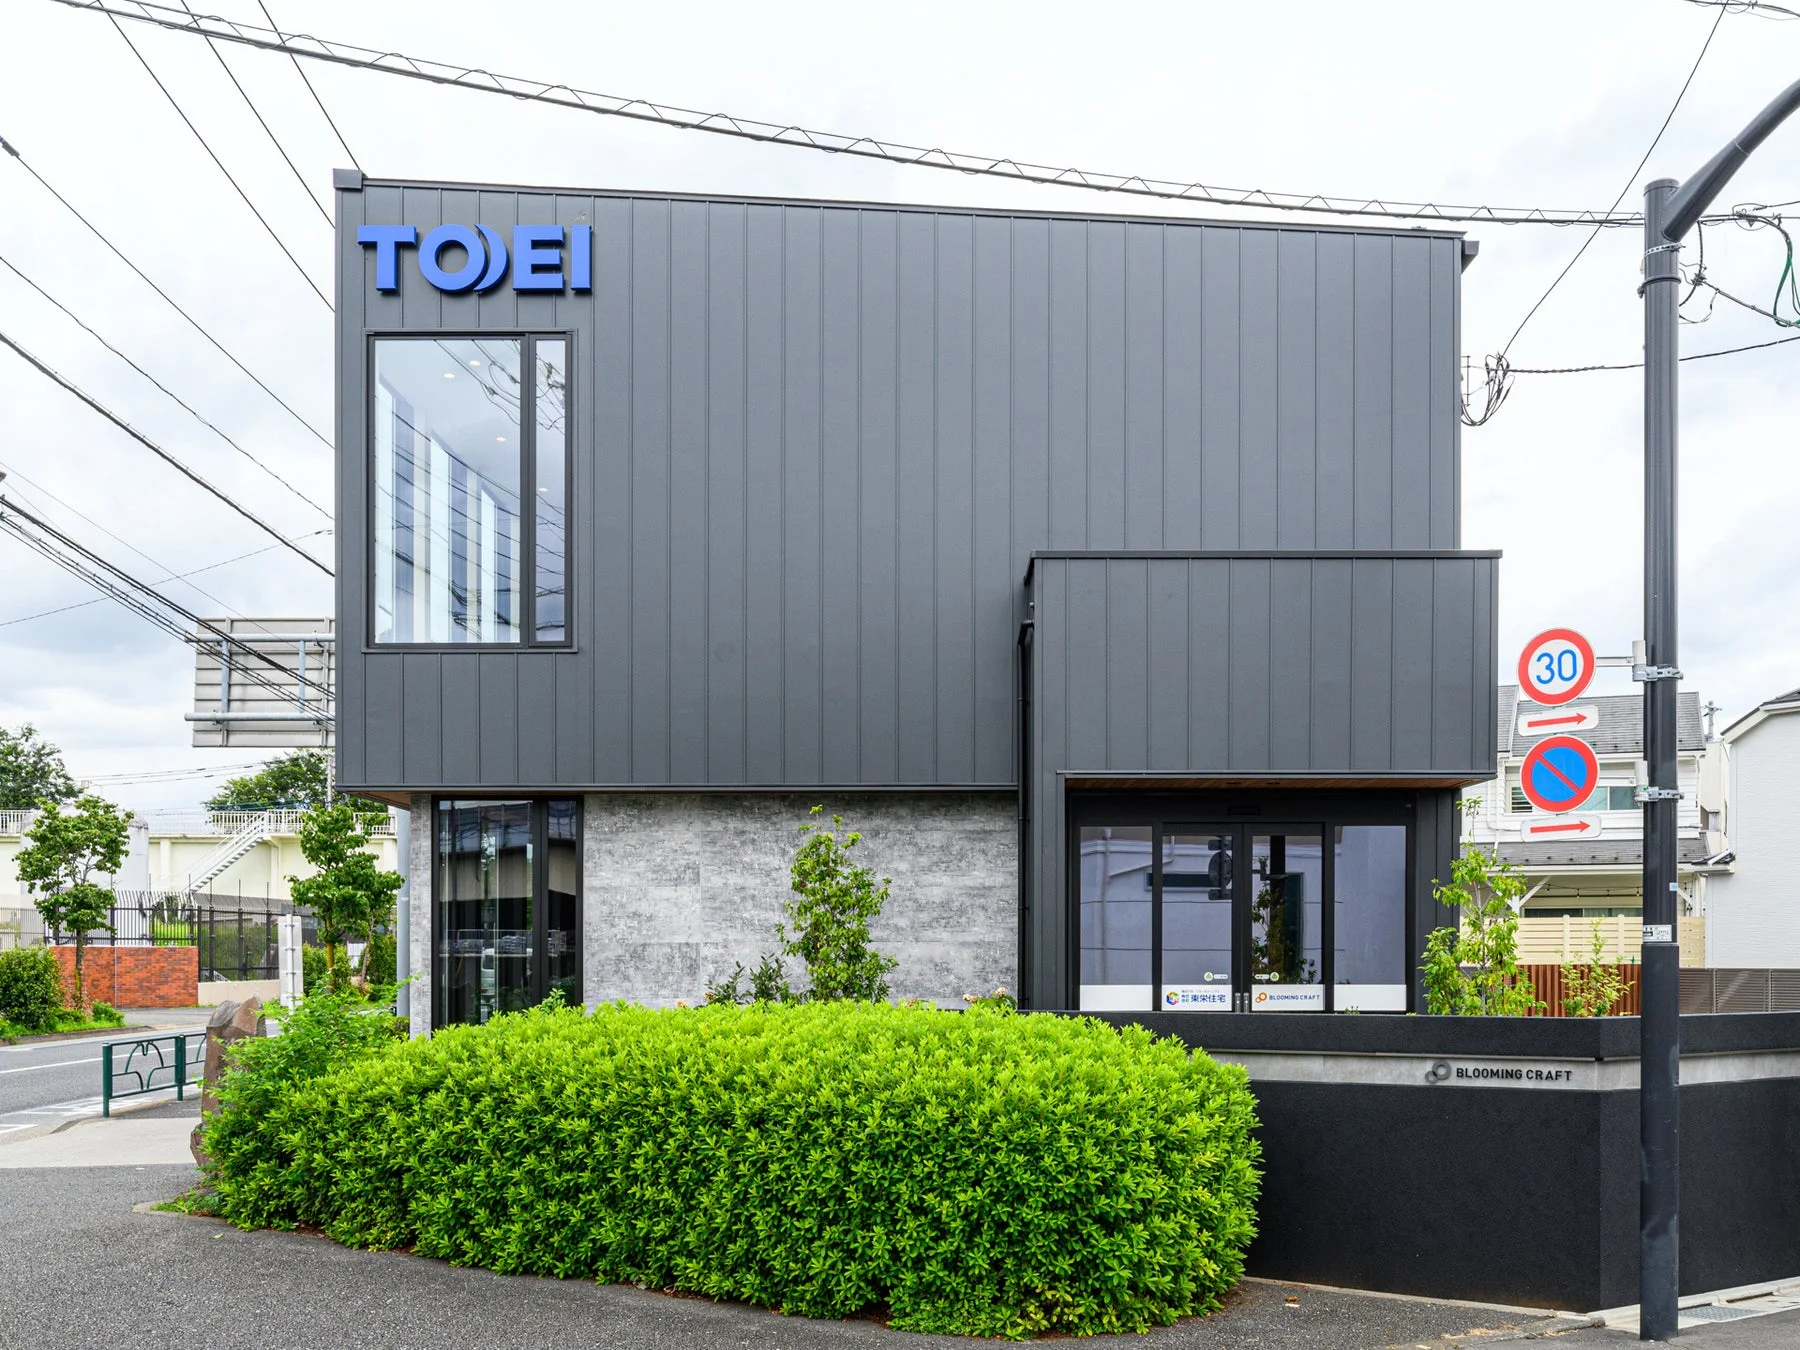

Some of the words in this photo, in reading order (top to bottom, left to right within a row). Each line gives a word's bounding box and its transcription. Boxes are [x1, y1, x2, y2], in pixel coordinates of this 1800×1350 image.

[1536, 649, 1577, 685] 30
[1191, 994, 1226, 1003] 東栄住宅
[1456, 1067, 1522, 1080] BLOOMING
[1526, 1069, 1572, 1081] CRAFT
